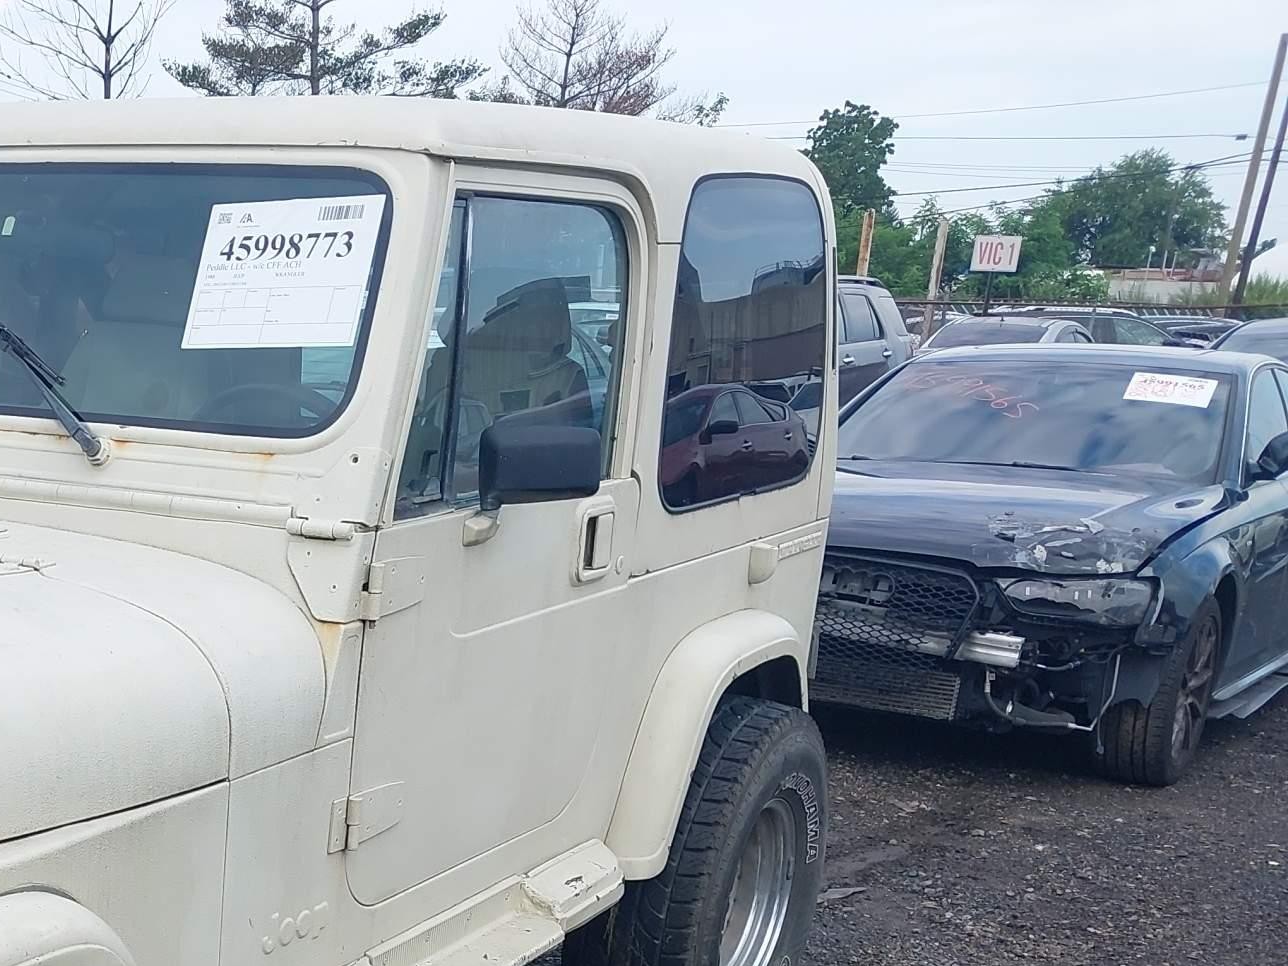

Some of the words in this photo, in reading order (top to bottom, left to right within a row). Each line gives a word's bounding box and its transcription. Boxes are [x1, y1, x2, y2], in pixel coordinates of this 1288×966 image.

[219, 230, 355, 261] 45998773
[979, 241, 1004, 265] VIC
[1008, 243, 1016, 265] 1
[260, 901, 329, 955] Jeep
